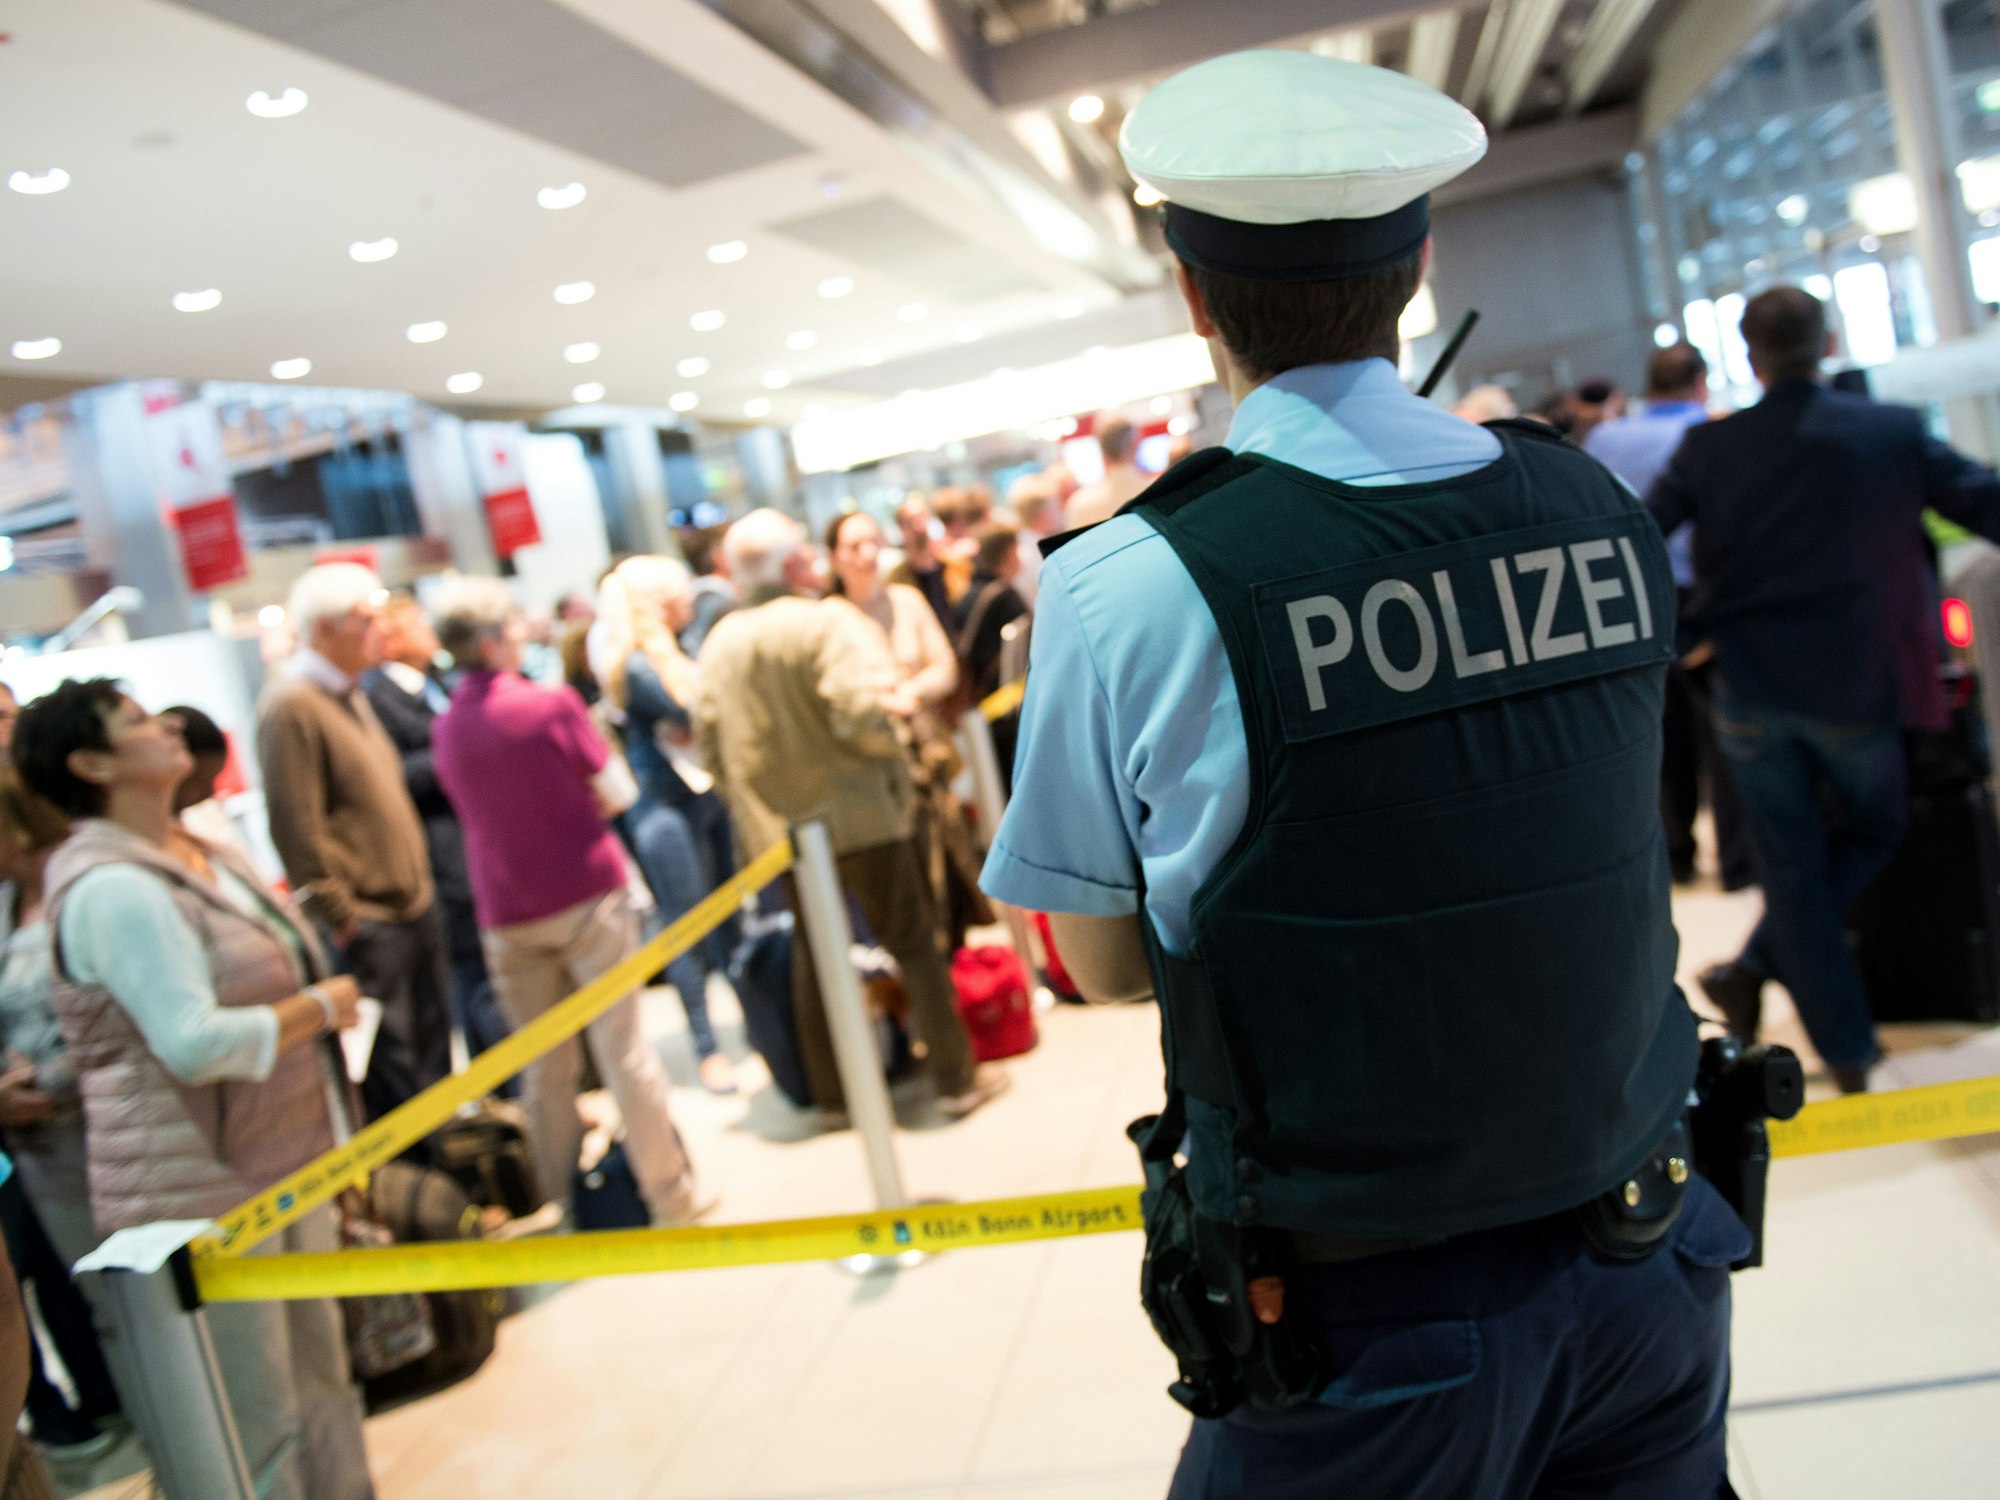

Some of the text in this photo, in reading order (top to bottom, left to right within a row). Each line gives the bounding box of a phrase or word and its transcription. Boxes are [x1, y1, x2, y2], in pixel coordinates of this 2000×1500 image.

[1285, 536, 1653, 712] POLIZEI
[922, 1204, 1127, 1239] Köln Bonn Airport
